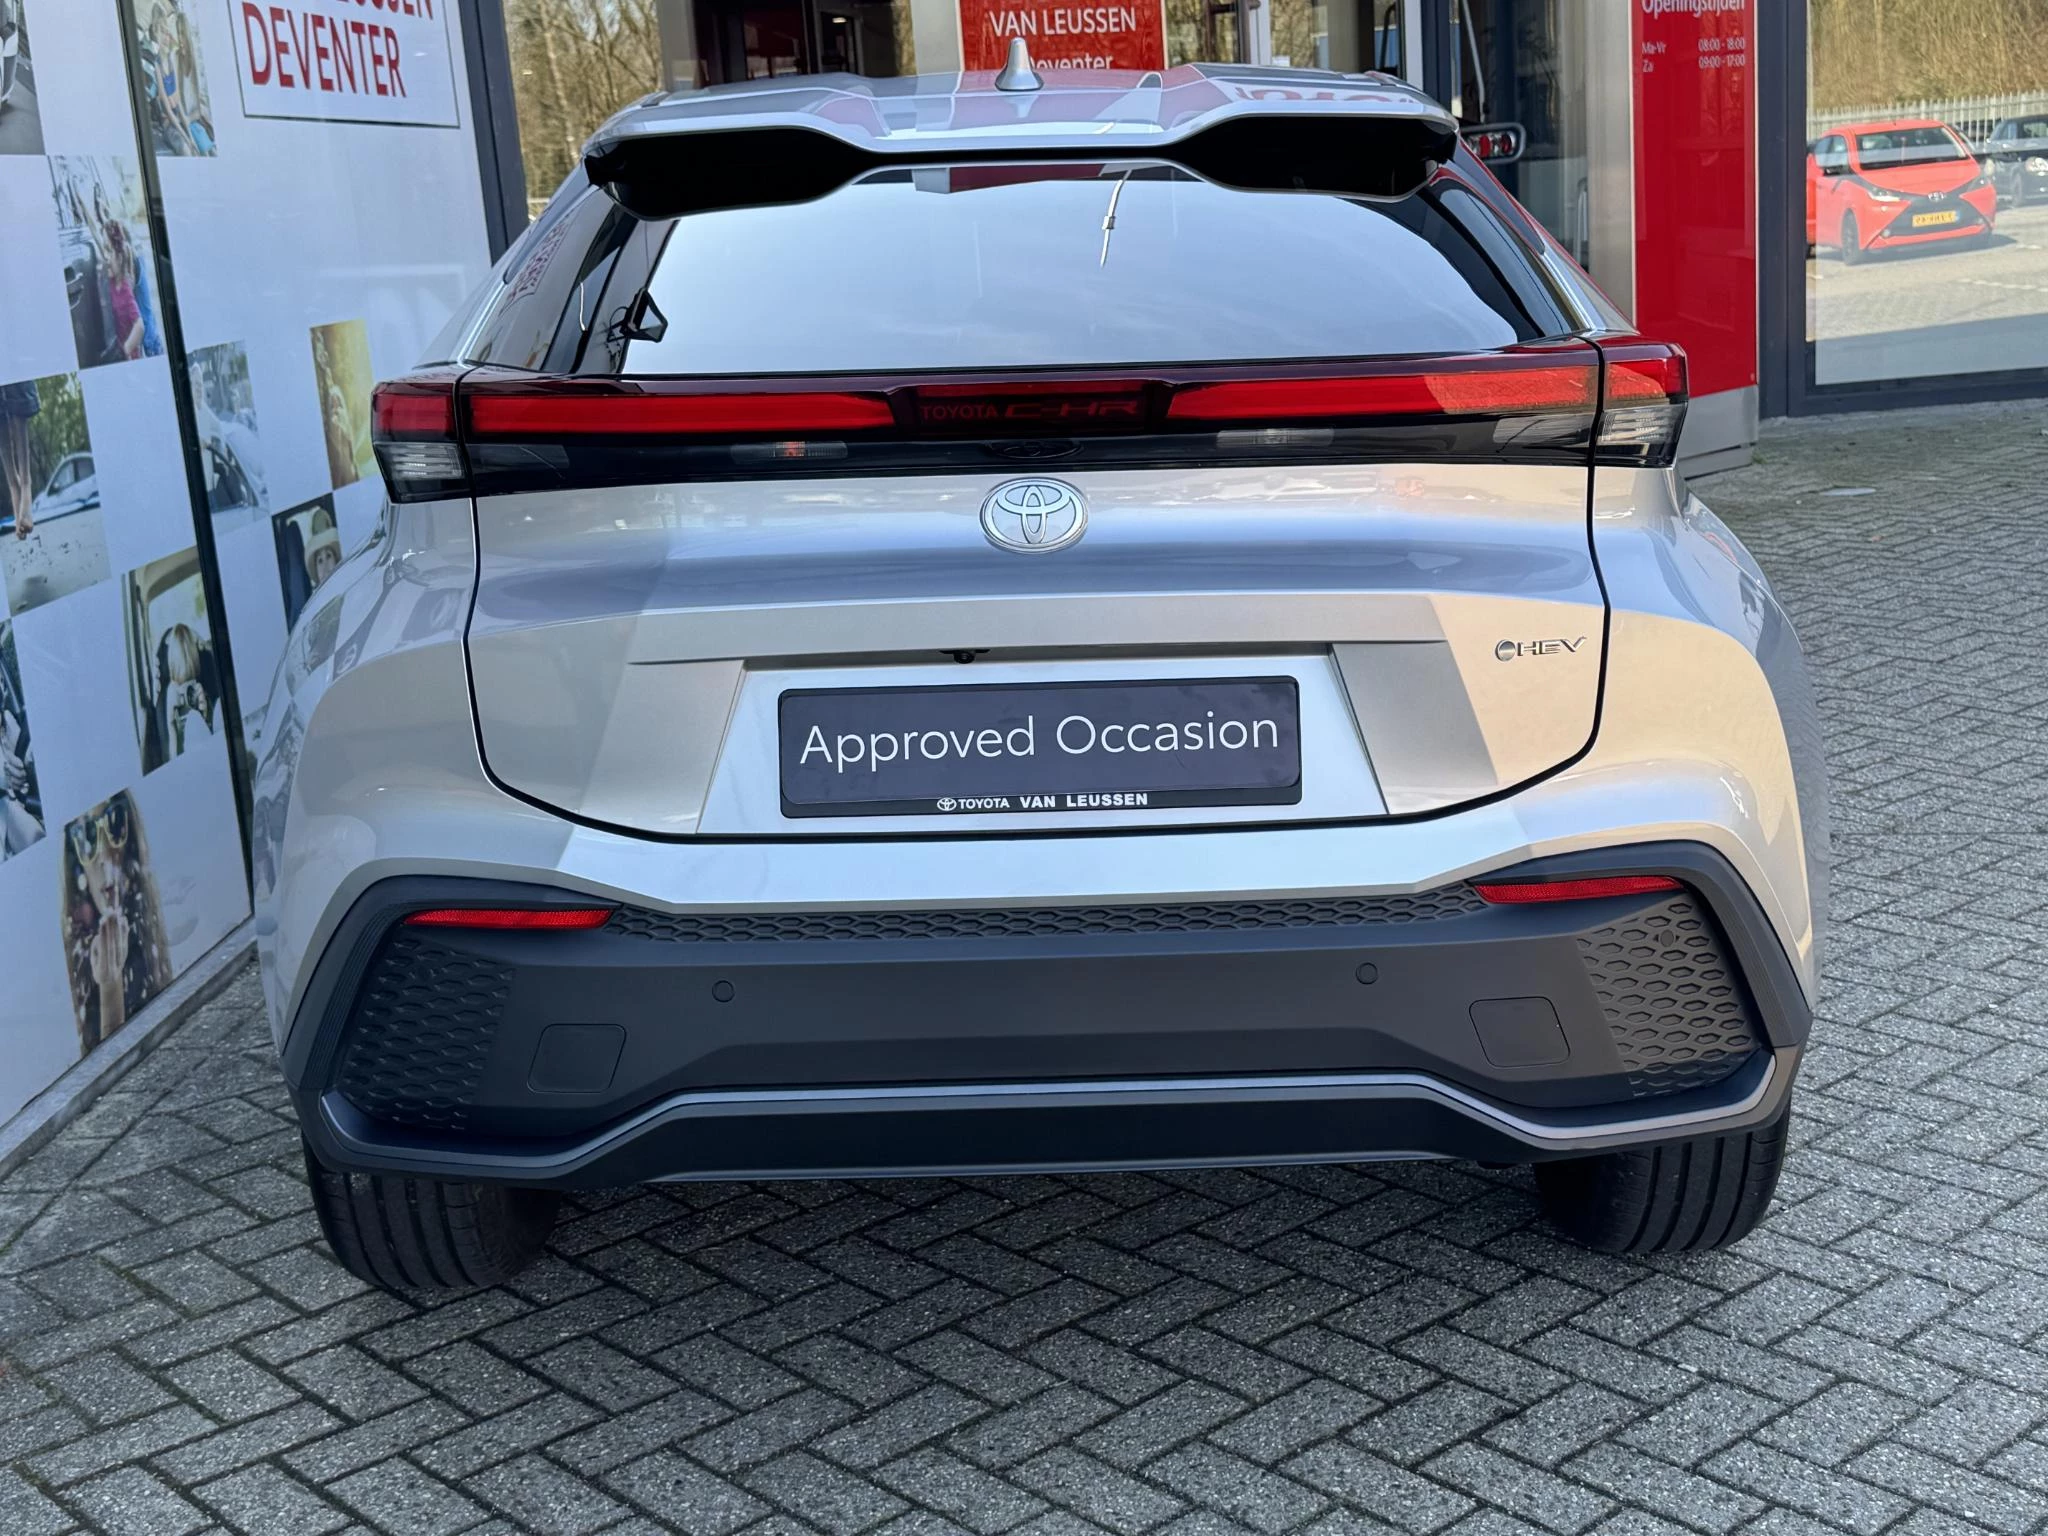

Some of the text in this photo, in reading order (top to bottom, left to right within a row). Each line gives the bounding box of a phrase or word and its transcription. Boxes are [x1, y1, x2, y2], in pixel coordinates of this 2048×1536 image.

[989, 7, 1136, 37] VAN LEUSSEN
[242, 2, 406, 98] DEVENTER
[1642, 59, 1654, 73] Za
[920, 400, 1138, 421] TOYOTA C-HR
[1517, 636, 1587, 656] HEV
[800, 711, 1278, 773] Approved Occasion
[958, 793, 1148, 809] TOYOTA VAN LEUSSEN
